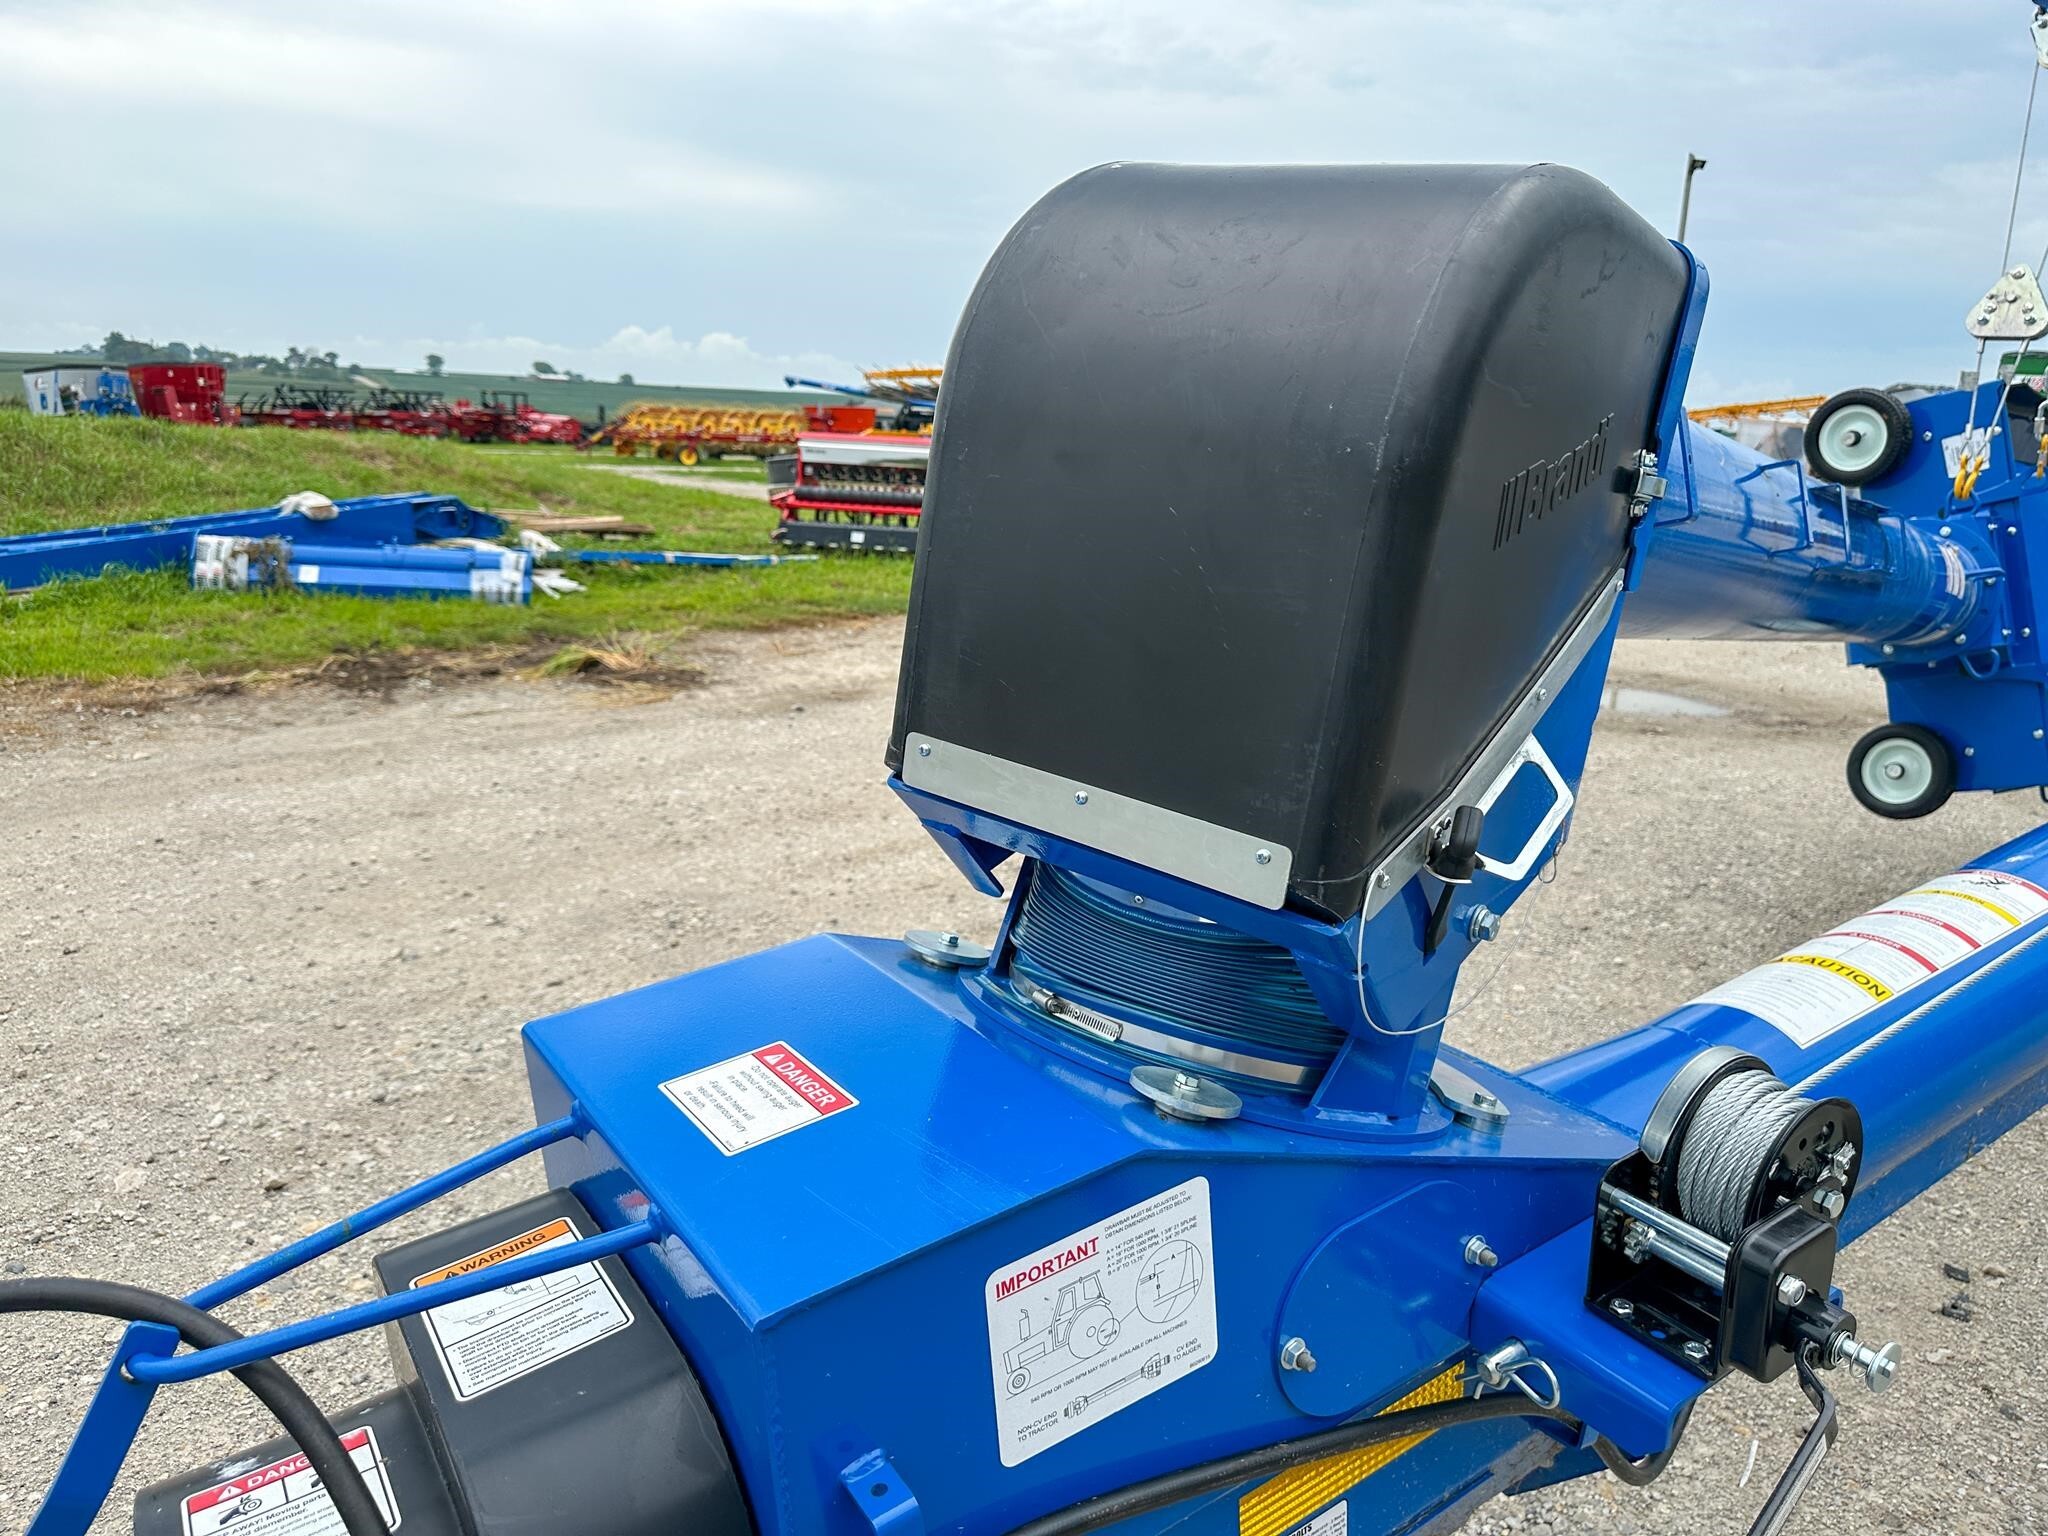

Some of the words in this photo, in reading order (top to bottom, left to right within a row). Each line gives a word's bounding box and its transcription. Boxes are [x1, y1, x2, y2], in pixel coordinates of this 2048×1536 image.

[1786, 955, 1886, 998] CAUTION
[748, 1064, 764, 1073] Do
[757, 1071, 771, 1080] not
[762, 1078, 790, 1097] operate
[772, 1060, 839, 1107] DANGER
[781, 1094, 804, 1110] auger
[1104, 1215, 1130, 1232] DRAWBAR
[1130, 1208, 1144, 1220] MUST
[1145, 1205, 1152, 1213] BE
[1152, 1192, 1178, 1210] ADJUSTED
[1178, 1189, 1186, 1198] TO
[1104, 1225, 1123, 1240] OBTAIN
[1124, 1210, 1155, 1230] DIMENSIONS
[1155, 1202, 1173, 1216] LISTED
[459, 1230, 546, 1274] WARNING
[1105, 1247, 1110, 1255] A
[1122, 1236, 1134, 1247] FOR
[1134, 1232, 1144, 1241] 540
[1143, 1226, 1156, 1237] RPM
[1106, 1254, 1111, 1262] A
[1123, 1243, 1135, 1254] FOR
[1135, 1237, 1146, 1248] 1000
[1173, 1222, 1179, 1230] 21
[1179, 1214, 1197, 1227] SPLINE
[1106, 1261, 1111, 1269] A
[1123, 1250, 1135, 1261] FOR
[1135, 1244, 1147, 1255] 1000
[1173, 1229, 1180, 1237] 20
[1180, 1221, 1197, 1234] SPLINE
[994, 1235, 1100, 1299] IMPORTANT
[1122, 1260, 1130, 1269] TO
[1170, 1252, 1176, 1260] A
[1155, 1282, 1160, 1290] B
[1172, 1352, 1181, 1363] TO
[1181, 1341, 1202, 1358] AUGER
[1176, 1342, 1185, 1353] CV
[1185, 1335, 1198, 1348] END
[1030, 1394, 1040, 1404] 540
[1040, 1387, 1053, 1399] RPM
[1053, 1383, 1062, 1392] OR
[1062, 1376, 1074, 1387] 1000
[1074, 1370, 1087, 1381] RPM
[1087, 1364, 1098, 1375] MAY
[1098, 1358, 1110, 1369] NOT
[1110, 1354, 1117, 1363] BE
[1118, 1341, 1144, 1359] AVAILABLE
[1144, 1336, 1152, 1346] ON
[1152, 1332, 1161, 1341] ALL
[1162, 1318, 1187, 1336] MACHINES
[1017, 1416, 1042, 1436] NON-CV
[1043, 1409, 1058, 1422] END
[1017, 1433, 1027, 1443] TO
[1027, 1416, 1059, 1438] TRACTOR
[246, 1455, 309, 1488] DANG
[230, 1516, 264, 1535] AWAY!
[265, 1502, 301, 1521] Moving
[301, 1492, 327, 1507] parts
[252, 1506, 309, 1533] dismember.
